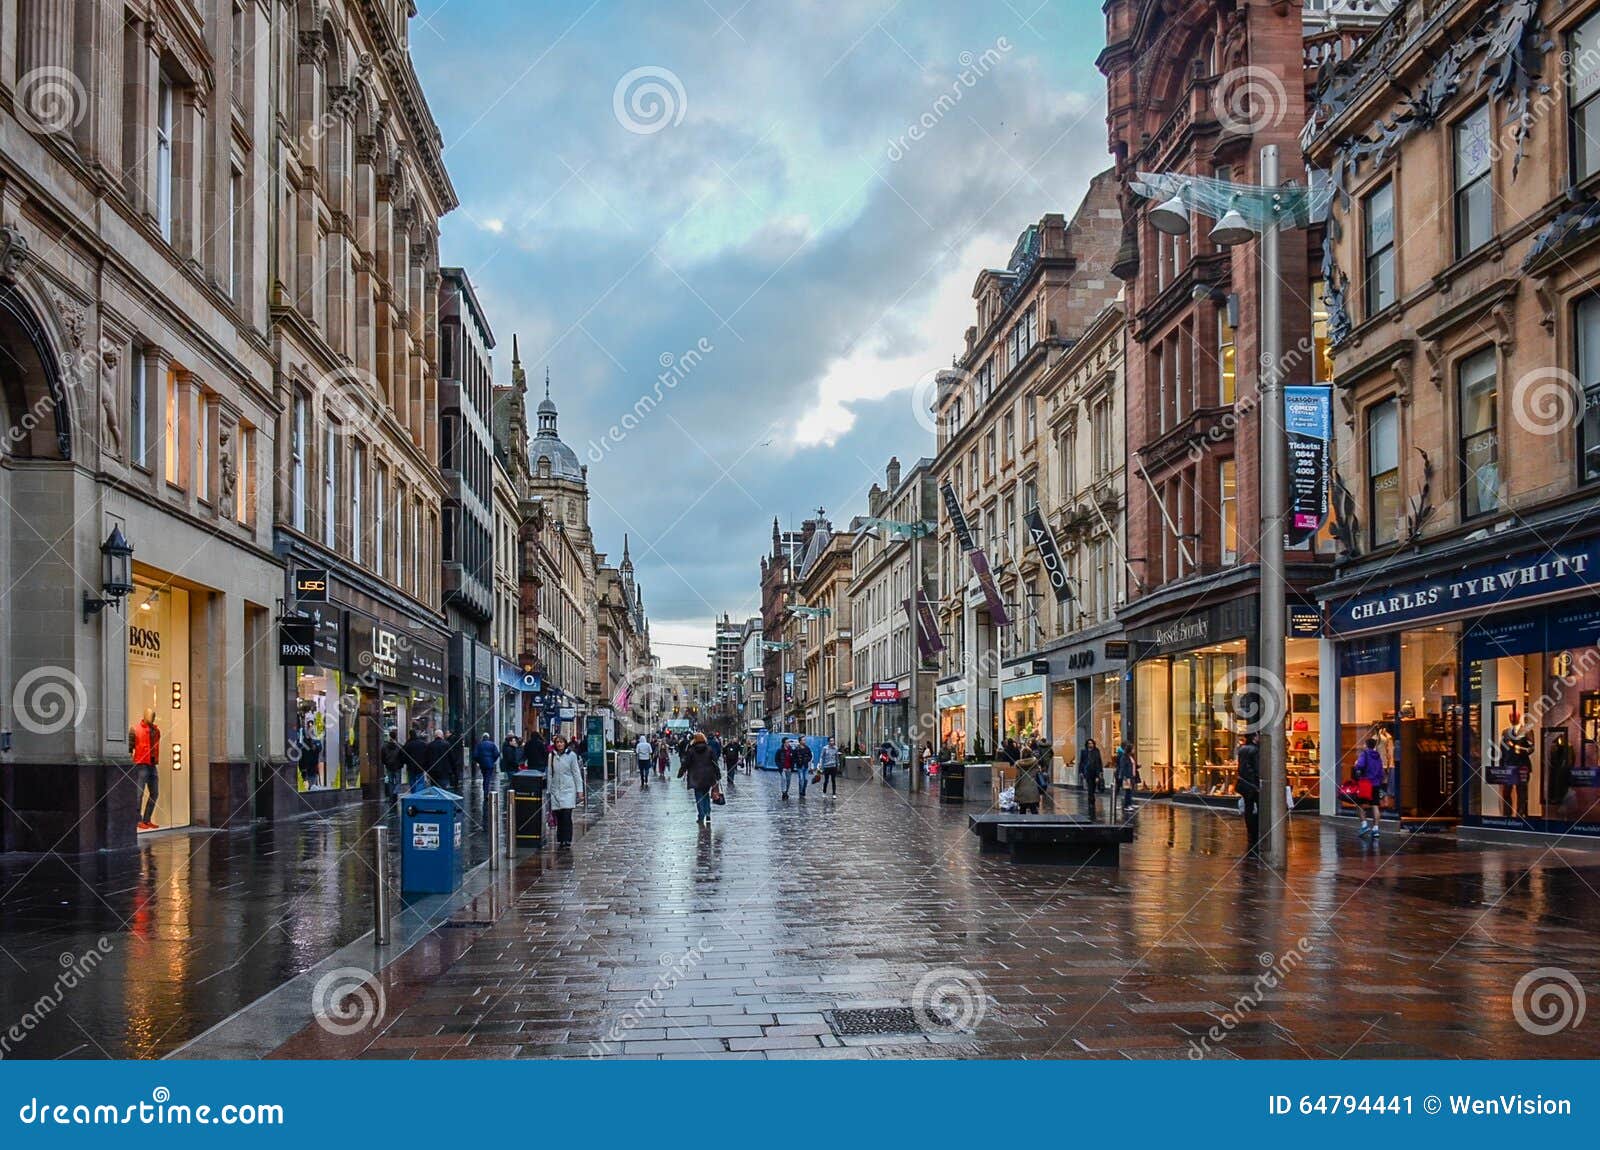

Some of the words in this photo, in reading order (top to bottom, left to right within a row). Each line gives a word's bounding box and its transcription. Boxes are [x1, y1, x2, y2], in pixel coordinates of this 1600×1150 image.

[1288, 442, 1321, 450] Tickets:
[1295, 451, 1315, 459] 0844
[1031, 528, 1064, 588] ALDO
[297, 581, 325, 591] USC
[1351, 587, 1438, 621] CHARLES
[1449, 553, 1589, 599] TYRWHITT
[129, 625, 160, 651] BOSS
[282, 644, 311, 653] BOSS
[876, 690, 886, 698] Let
[887, 689, 896, 699] By
